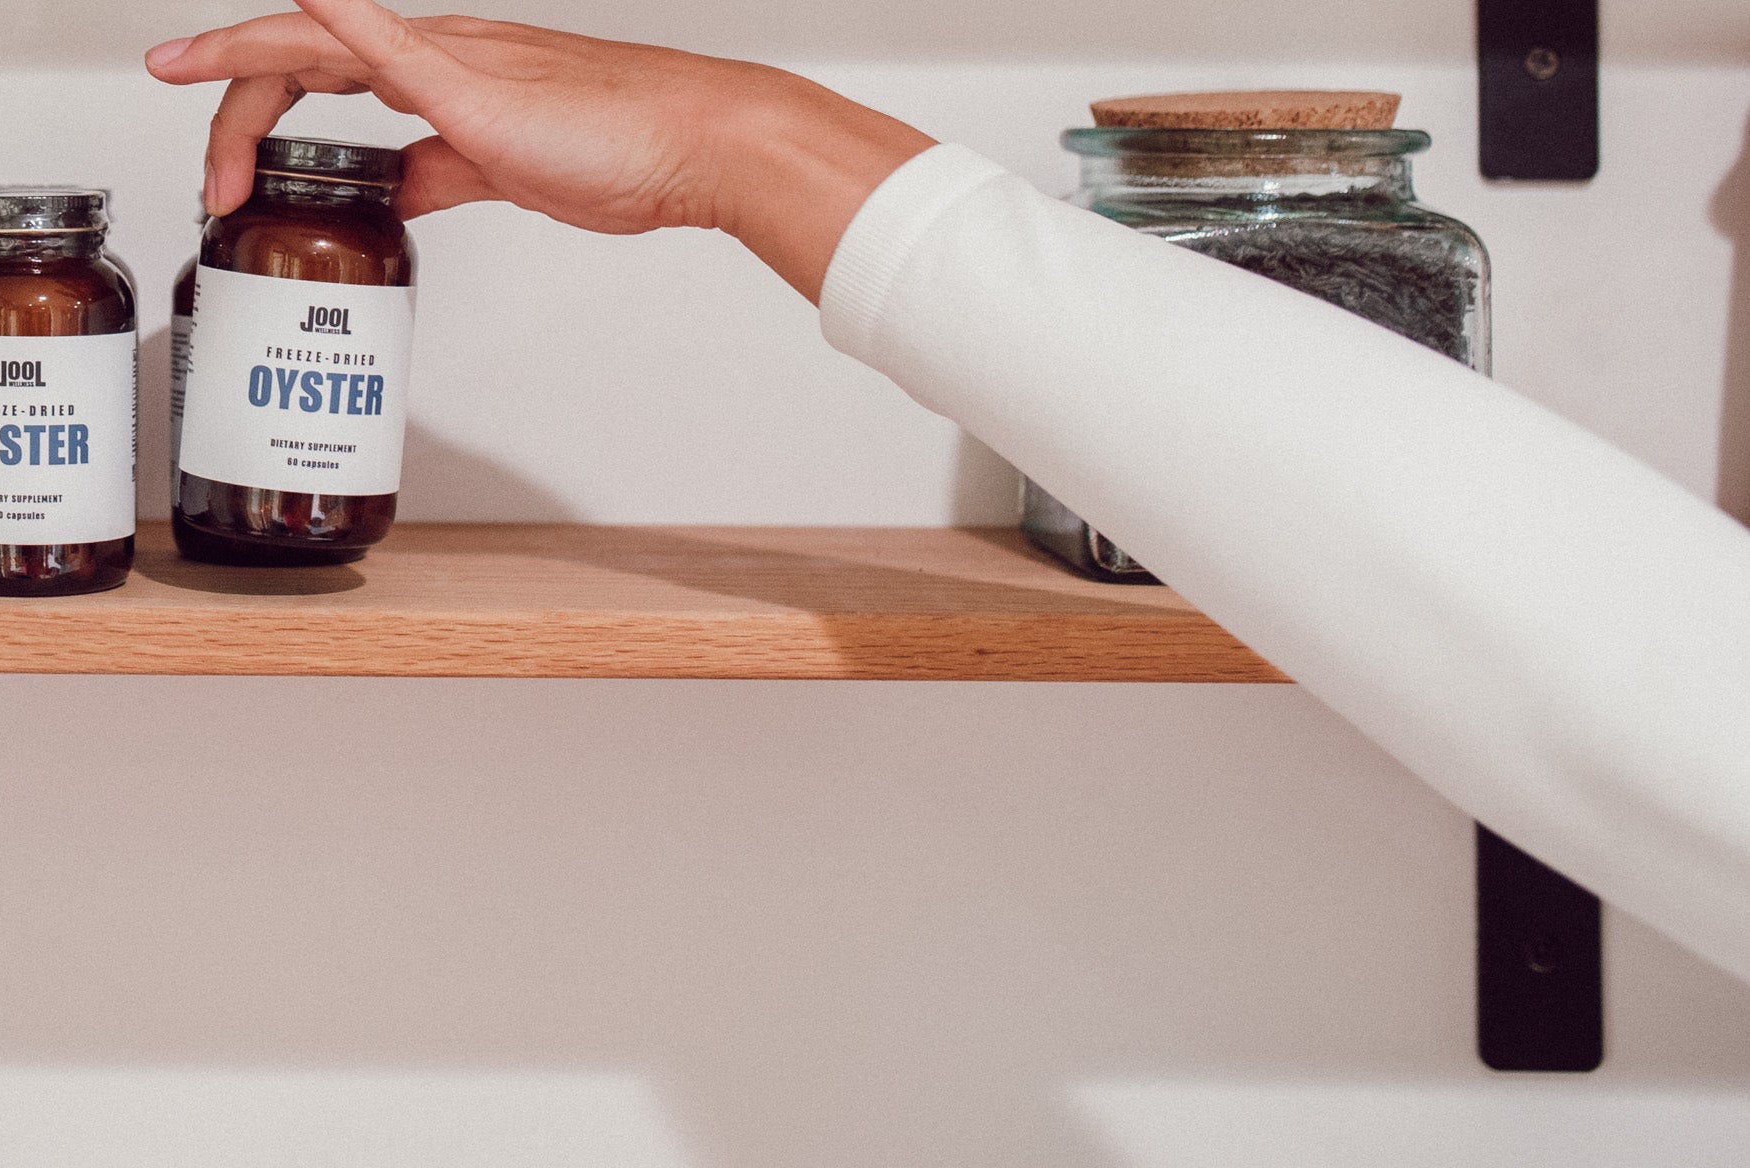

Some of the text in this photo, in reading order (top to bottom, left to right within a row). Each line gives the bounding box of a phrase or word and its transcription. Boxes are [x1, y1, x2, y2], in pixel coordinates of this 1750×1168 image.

[300, 305, 352, 335] JOOL
[315, 327, 340, 335] WELLNESS
[266, 346, 376, 366] FREEZE-DRIED
[248, 364, 384, 416] OYSTER
[270, 438, 357, 453] DIETARY SUPPLEMENT
[287, 457, 339, 469] 60 capsules
[11, 494, 63, 503] SUPPLEMENT
[6, 511, 45, 521] capsules
